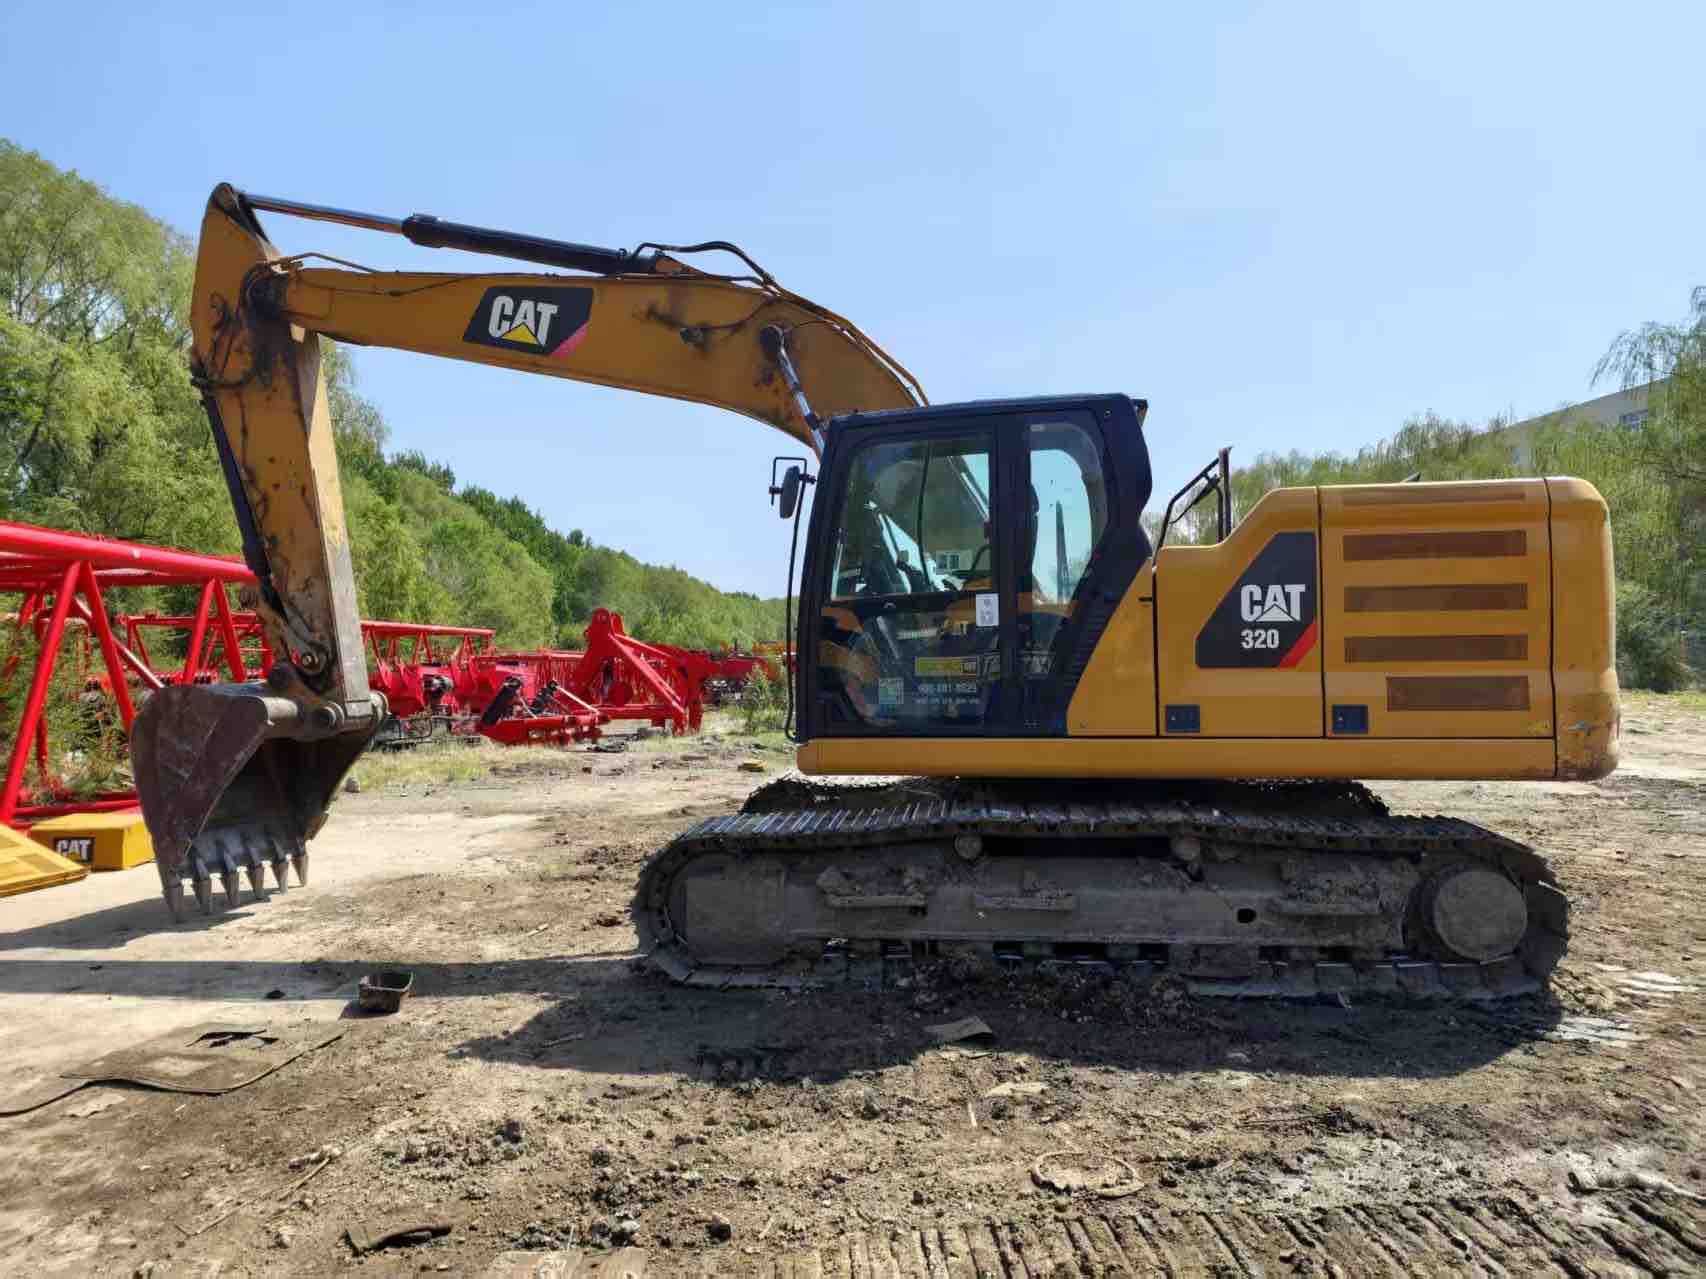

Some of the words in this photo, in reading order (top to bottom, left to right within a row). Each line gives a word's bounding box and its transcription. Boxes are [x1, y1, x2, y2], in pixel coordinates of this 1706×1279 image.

[488, 295, 558, 346] CAT
[1241, 584, 1305, 622] CAT
[1241, 629, 1279, 649] 320
[56, 839, 91, 860] CAT
